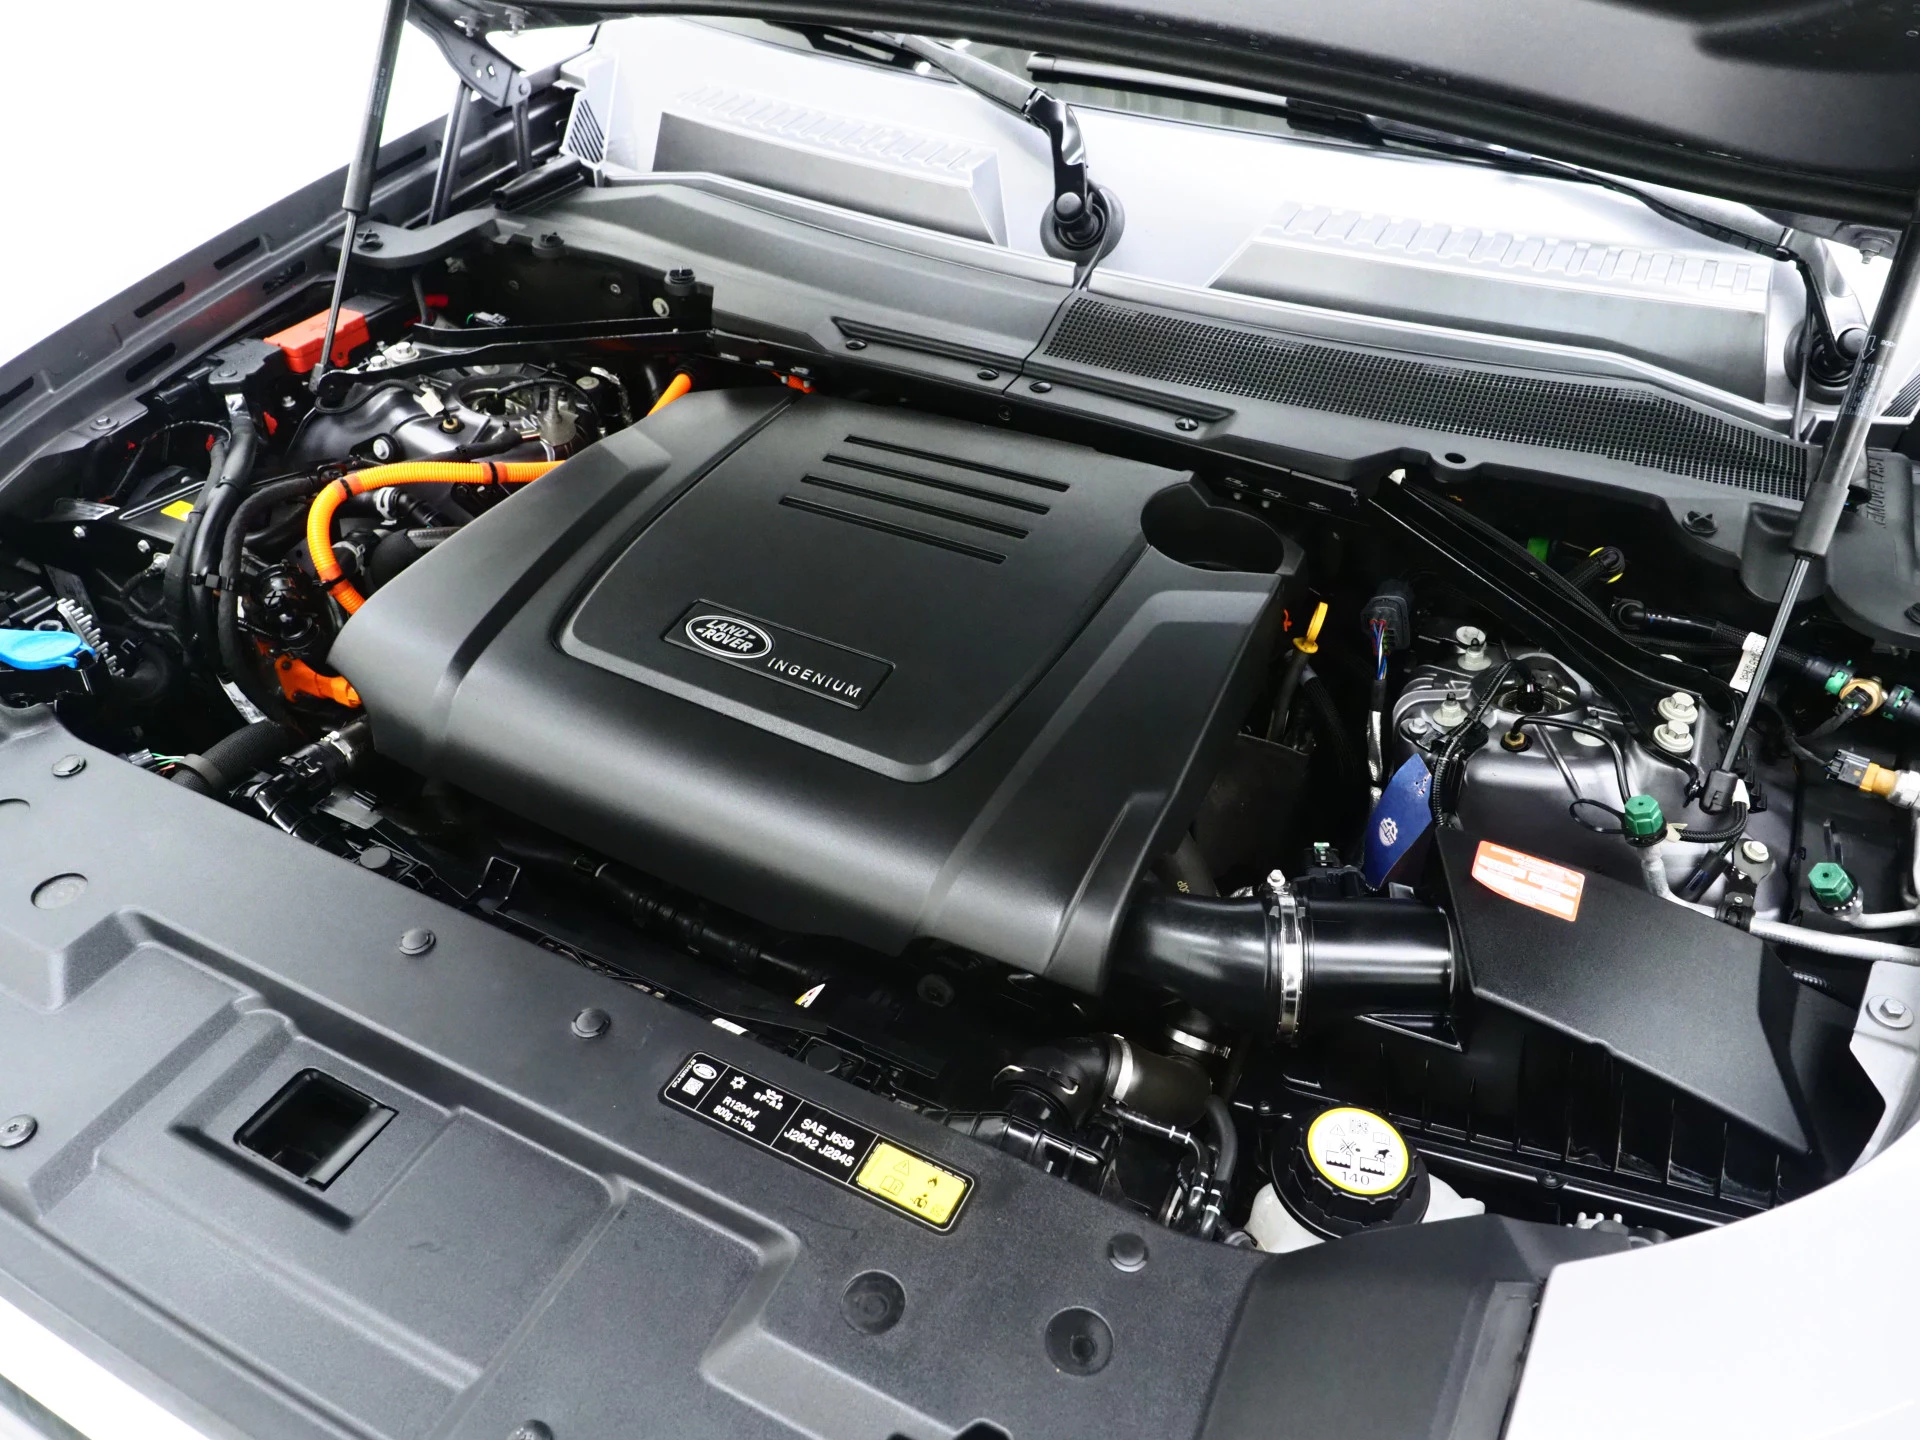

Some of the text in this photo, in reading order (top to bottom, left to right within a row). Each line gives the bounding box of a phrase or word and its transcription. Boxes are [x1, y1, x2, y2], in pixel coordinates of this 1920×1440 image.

[702, 628, 754, 652] ROVER
[705, 619, 749, 639] LAND
[767, 657, 862, 698] INGENIUM
[713, 1104, 733, 1121] 800g
[722, 1095, 760, 1118] R1234yf
[800, 1118, 855, 1150] SAE J639
[783, 1128, 819, 1150] J2842
[818, 1144, 855, 1167] J2845
[1341, 1171, 1370, 1186] 140
